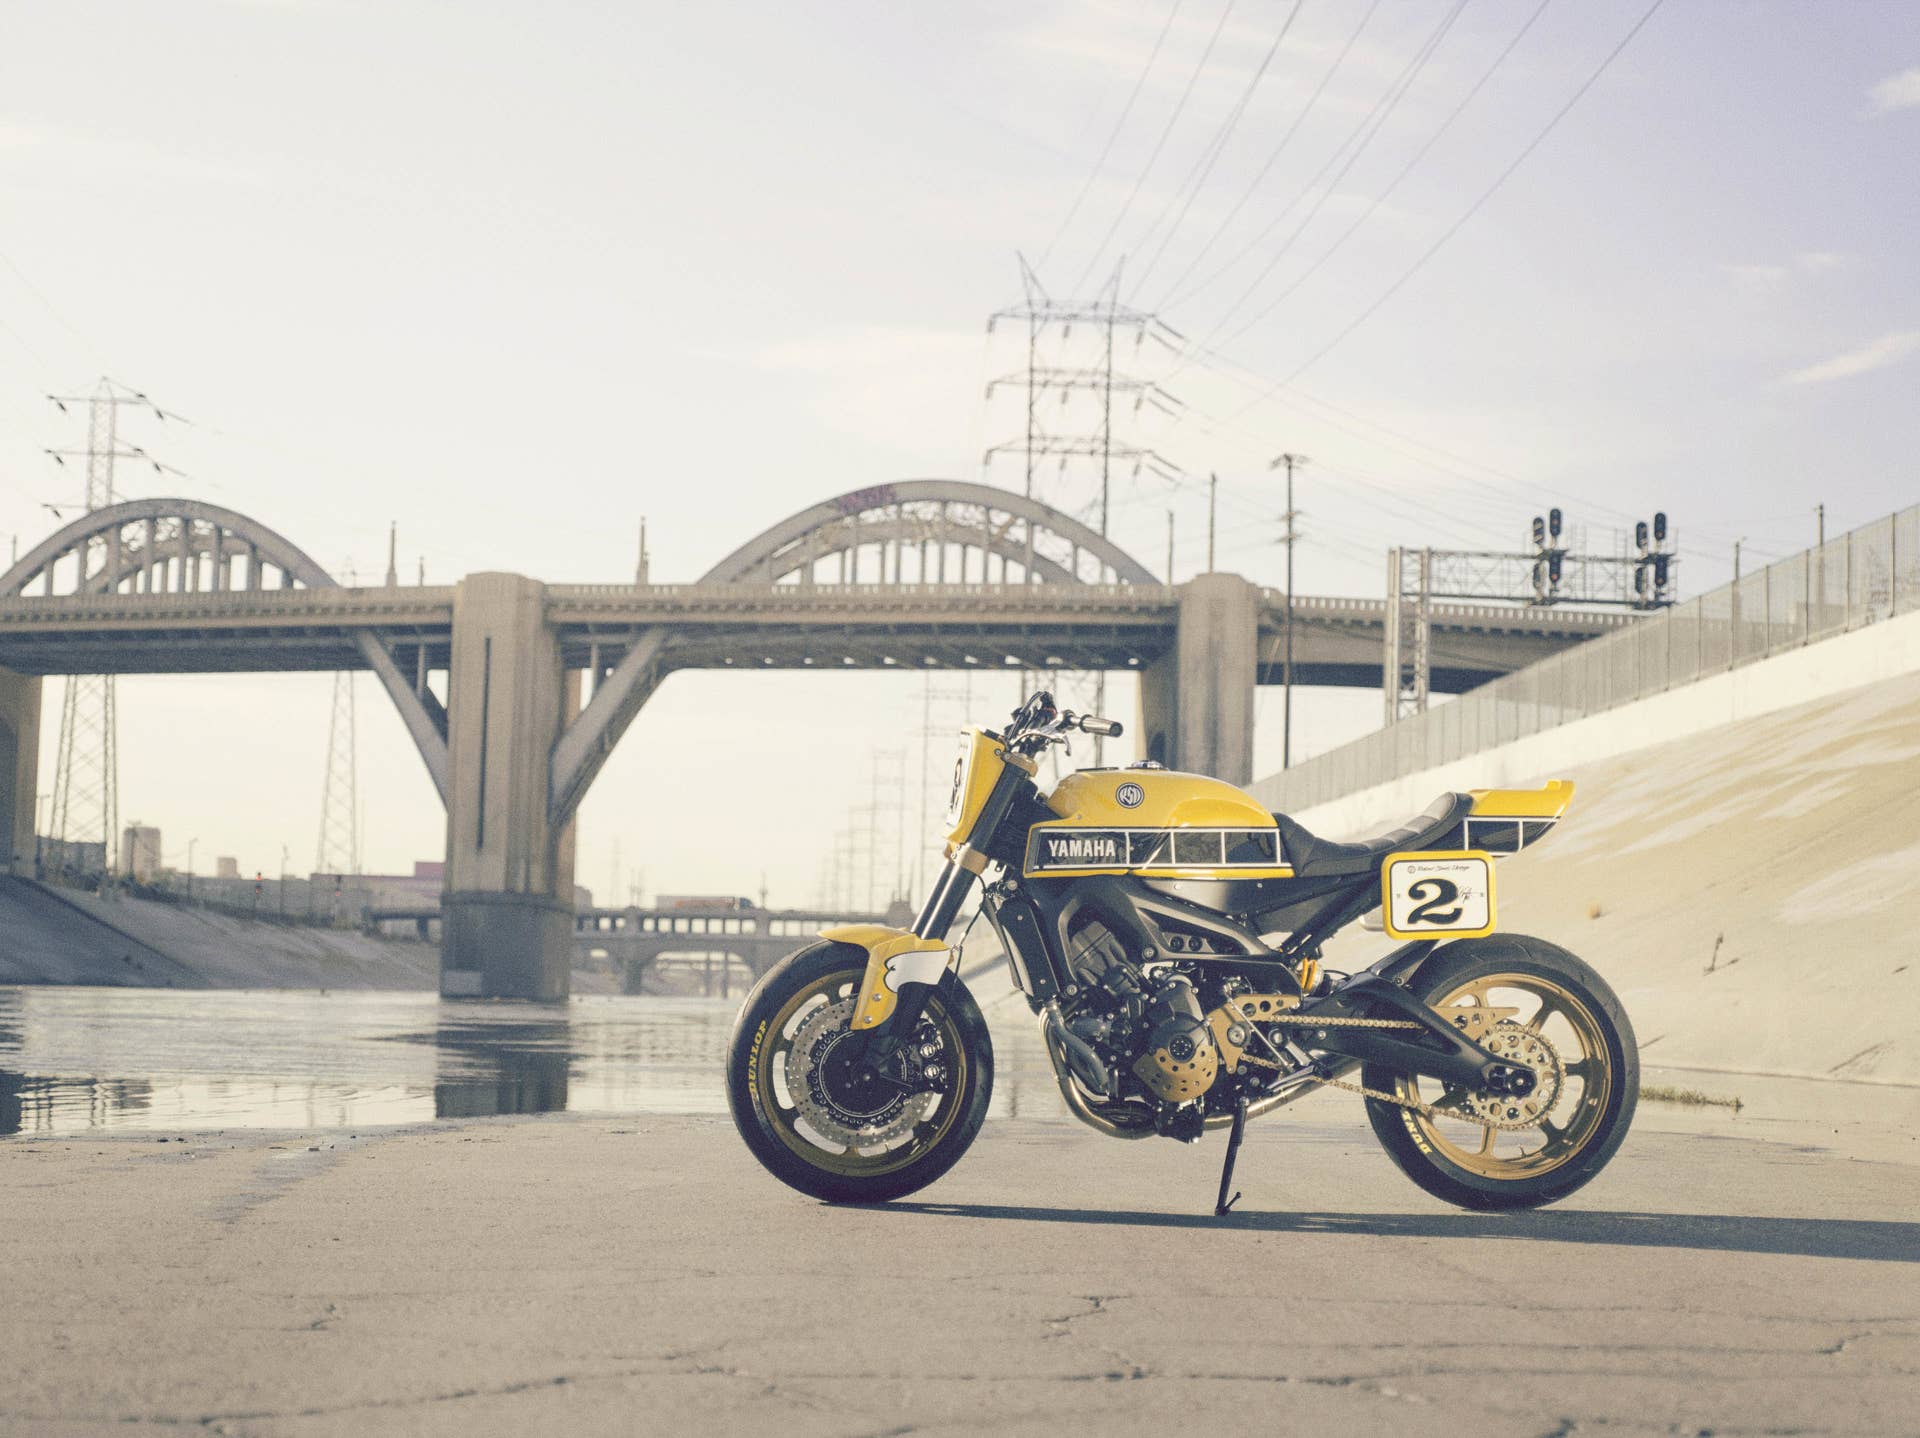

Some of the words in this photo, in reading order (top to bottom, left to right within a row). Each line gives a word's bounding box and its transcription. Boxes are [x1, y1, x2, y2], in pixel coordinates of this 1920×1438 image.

[1048, 839, 1116, 857] YAMAHA
[1407, 878, 1463, 925] 2
[748, 1019, 767, 1096] DUNLOP
[1396, 1086, 1433, 1154] DUNLP
